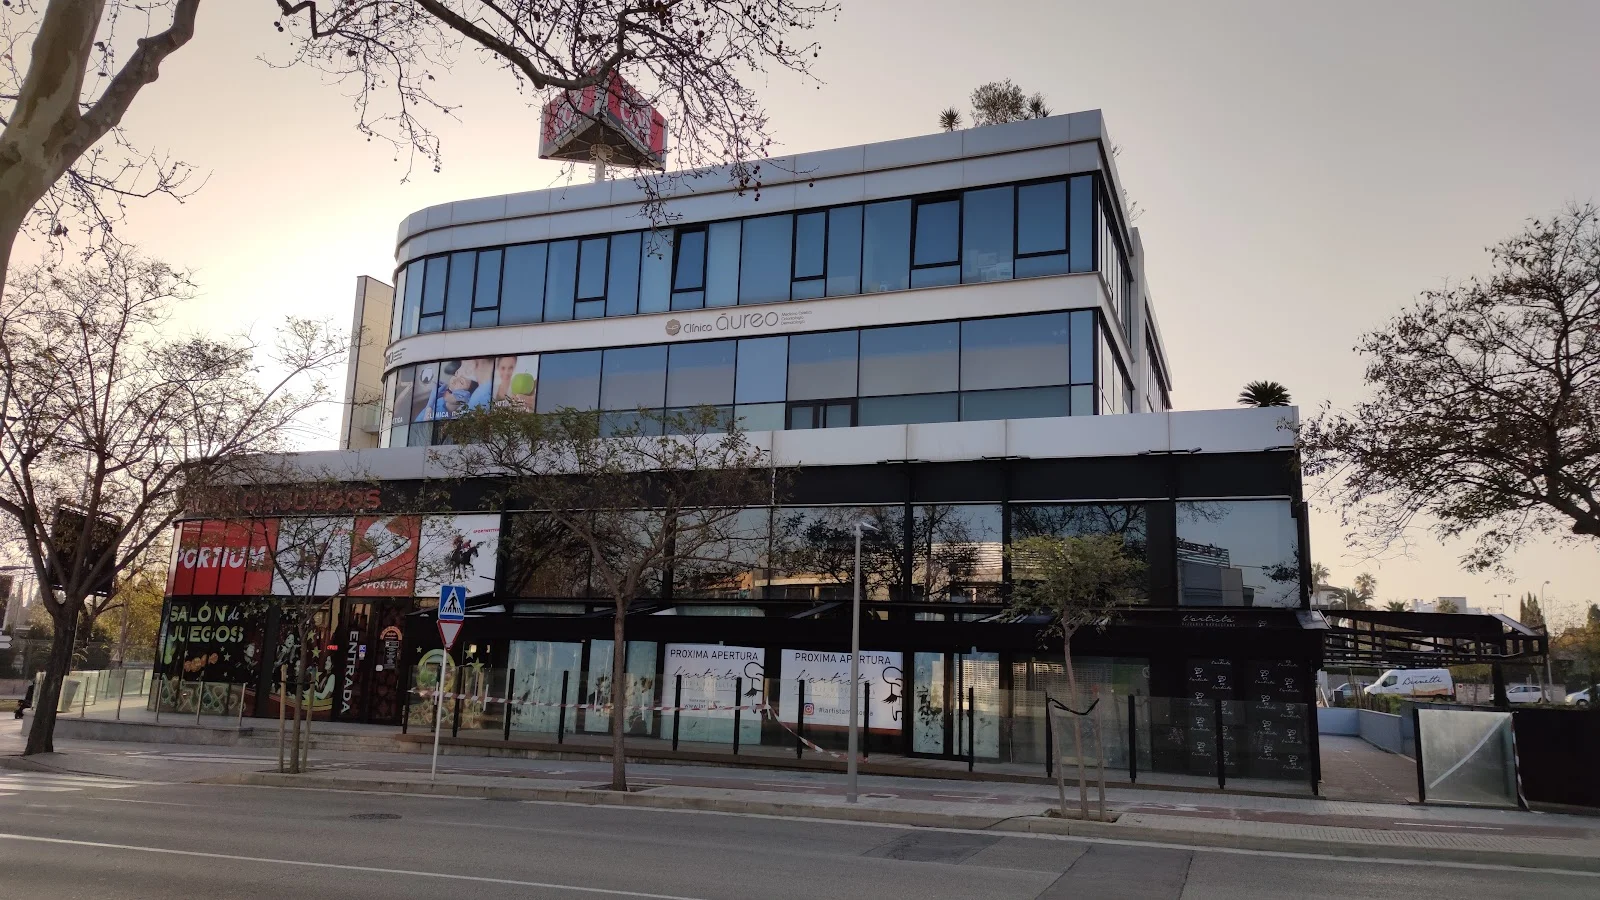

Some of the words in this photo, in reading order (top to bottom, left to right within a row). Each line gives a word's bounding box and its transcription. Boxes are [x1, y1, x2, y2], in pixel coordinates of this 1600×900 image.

[170, 601, 228, 622] SALÓN
[228, 606, 240, 621] de
[170, 625, 244, 643] JUEGOS
[670, 649, 709, 659] PROXIMA
[711, 651, 758, 661] APERTURA
[795, 652, 837, 663] PROXIMA
[839, 655, 891, 665] APRTURA
[341, 630, 360, 714] ENTRADA
